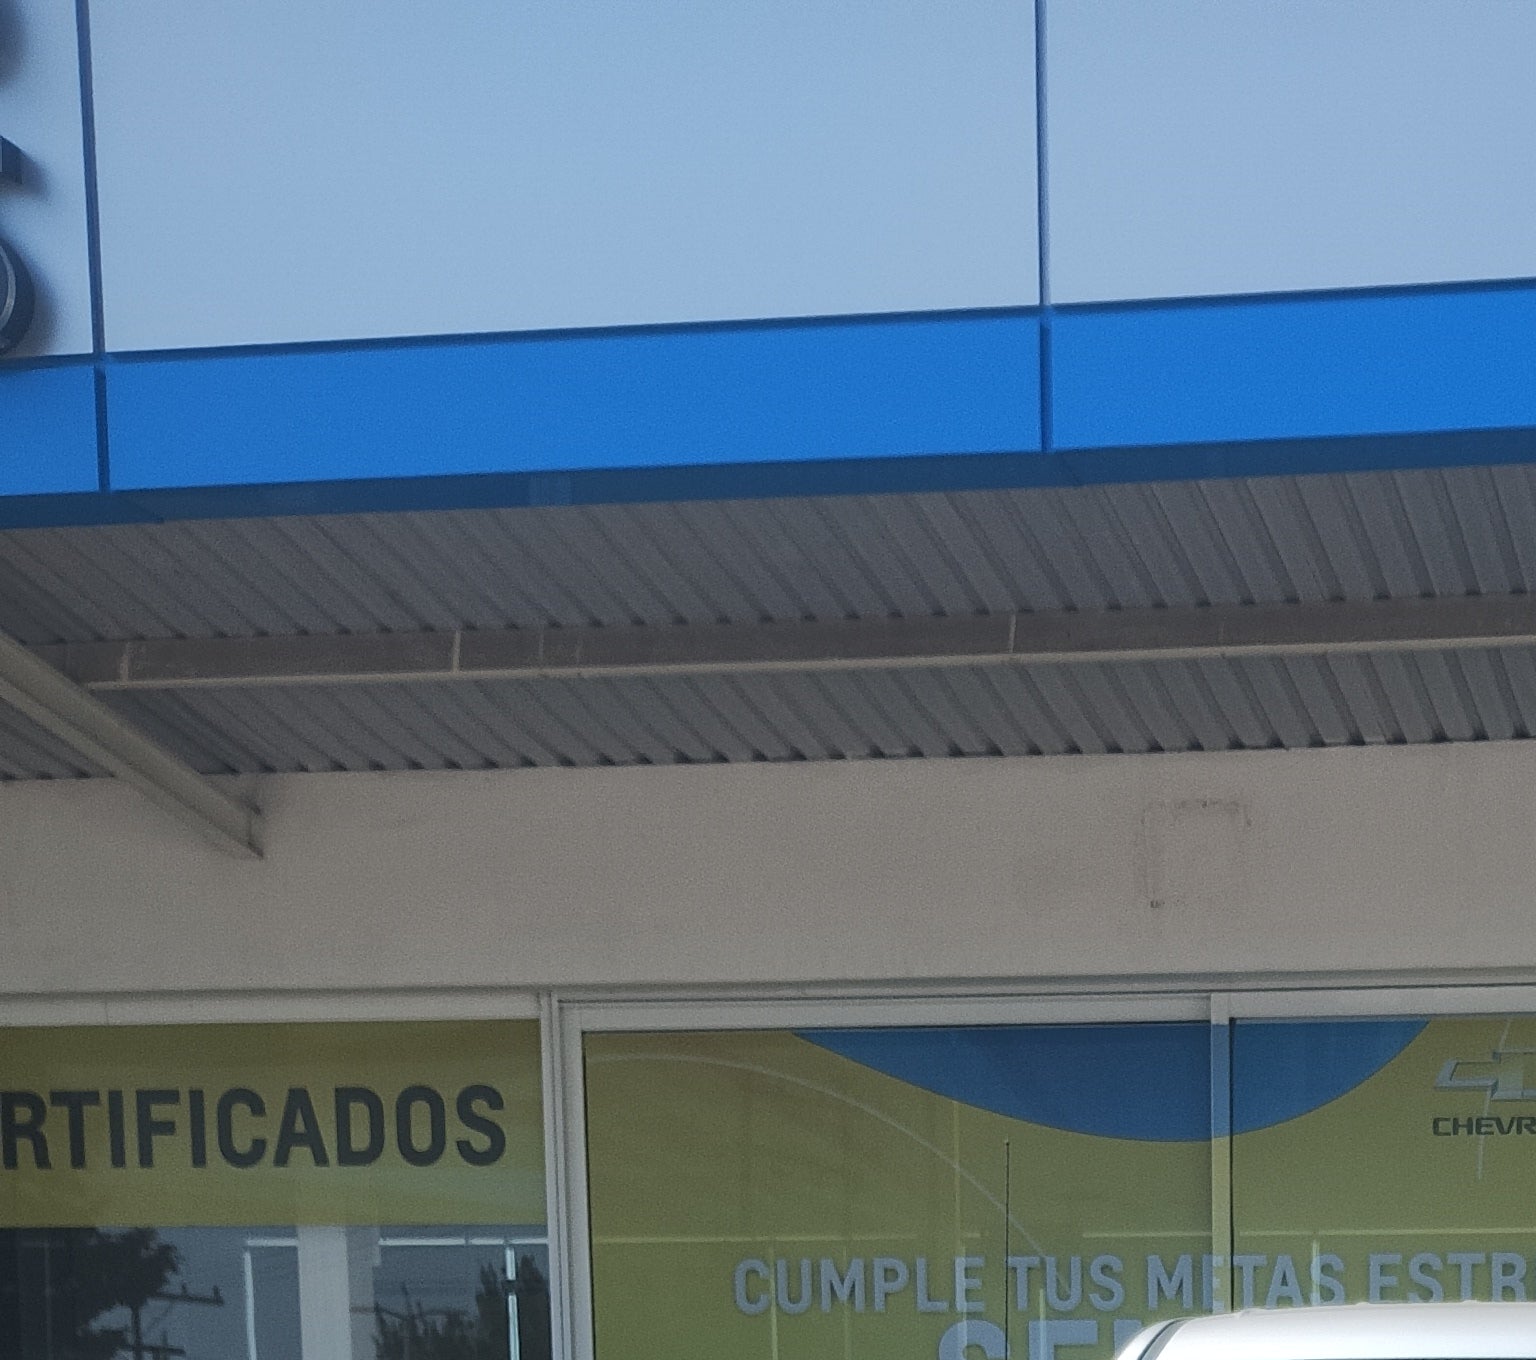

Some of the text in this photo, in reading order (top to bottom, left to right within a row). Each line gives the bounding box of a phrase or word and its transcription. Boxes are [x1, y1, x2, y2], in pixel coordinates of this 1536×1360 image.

[0, 1083, 507, 1171] RTIFICADOS
[733, 1256, 986, 1315] CUMPLE
[1006, 1255, 1126, 1312] TUS
[1147, 1253, 1346, 1313] METAS
